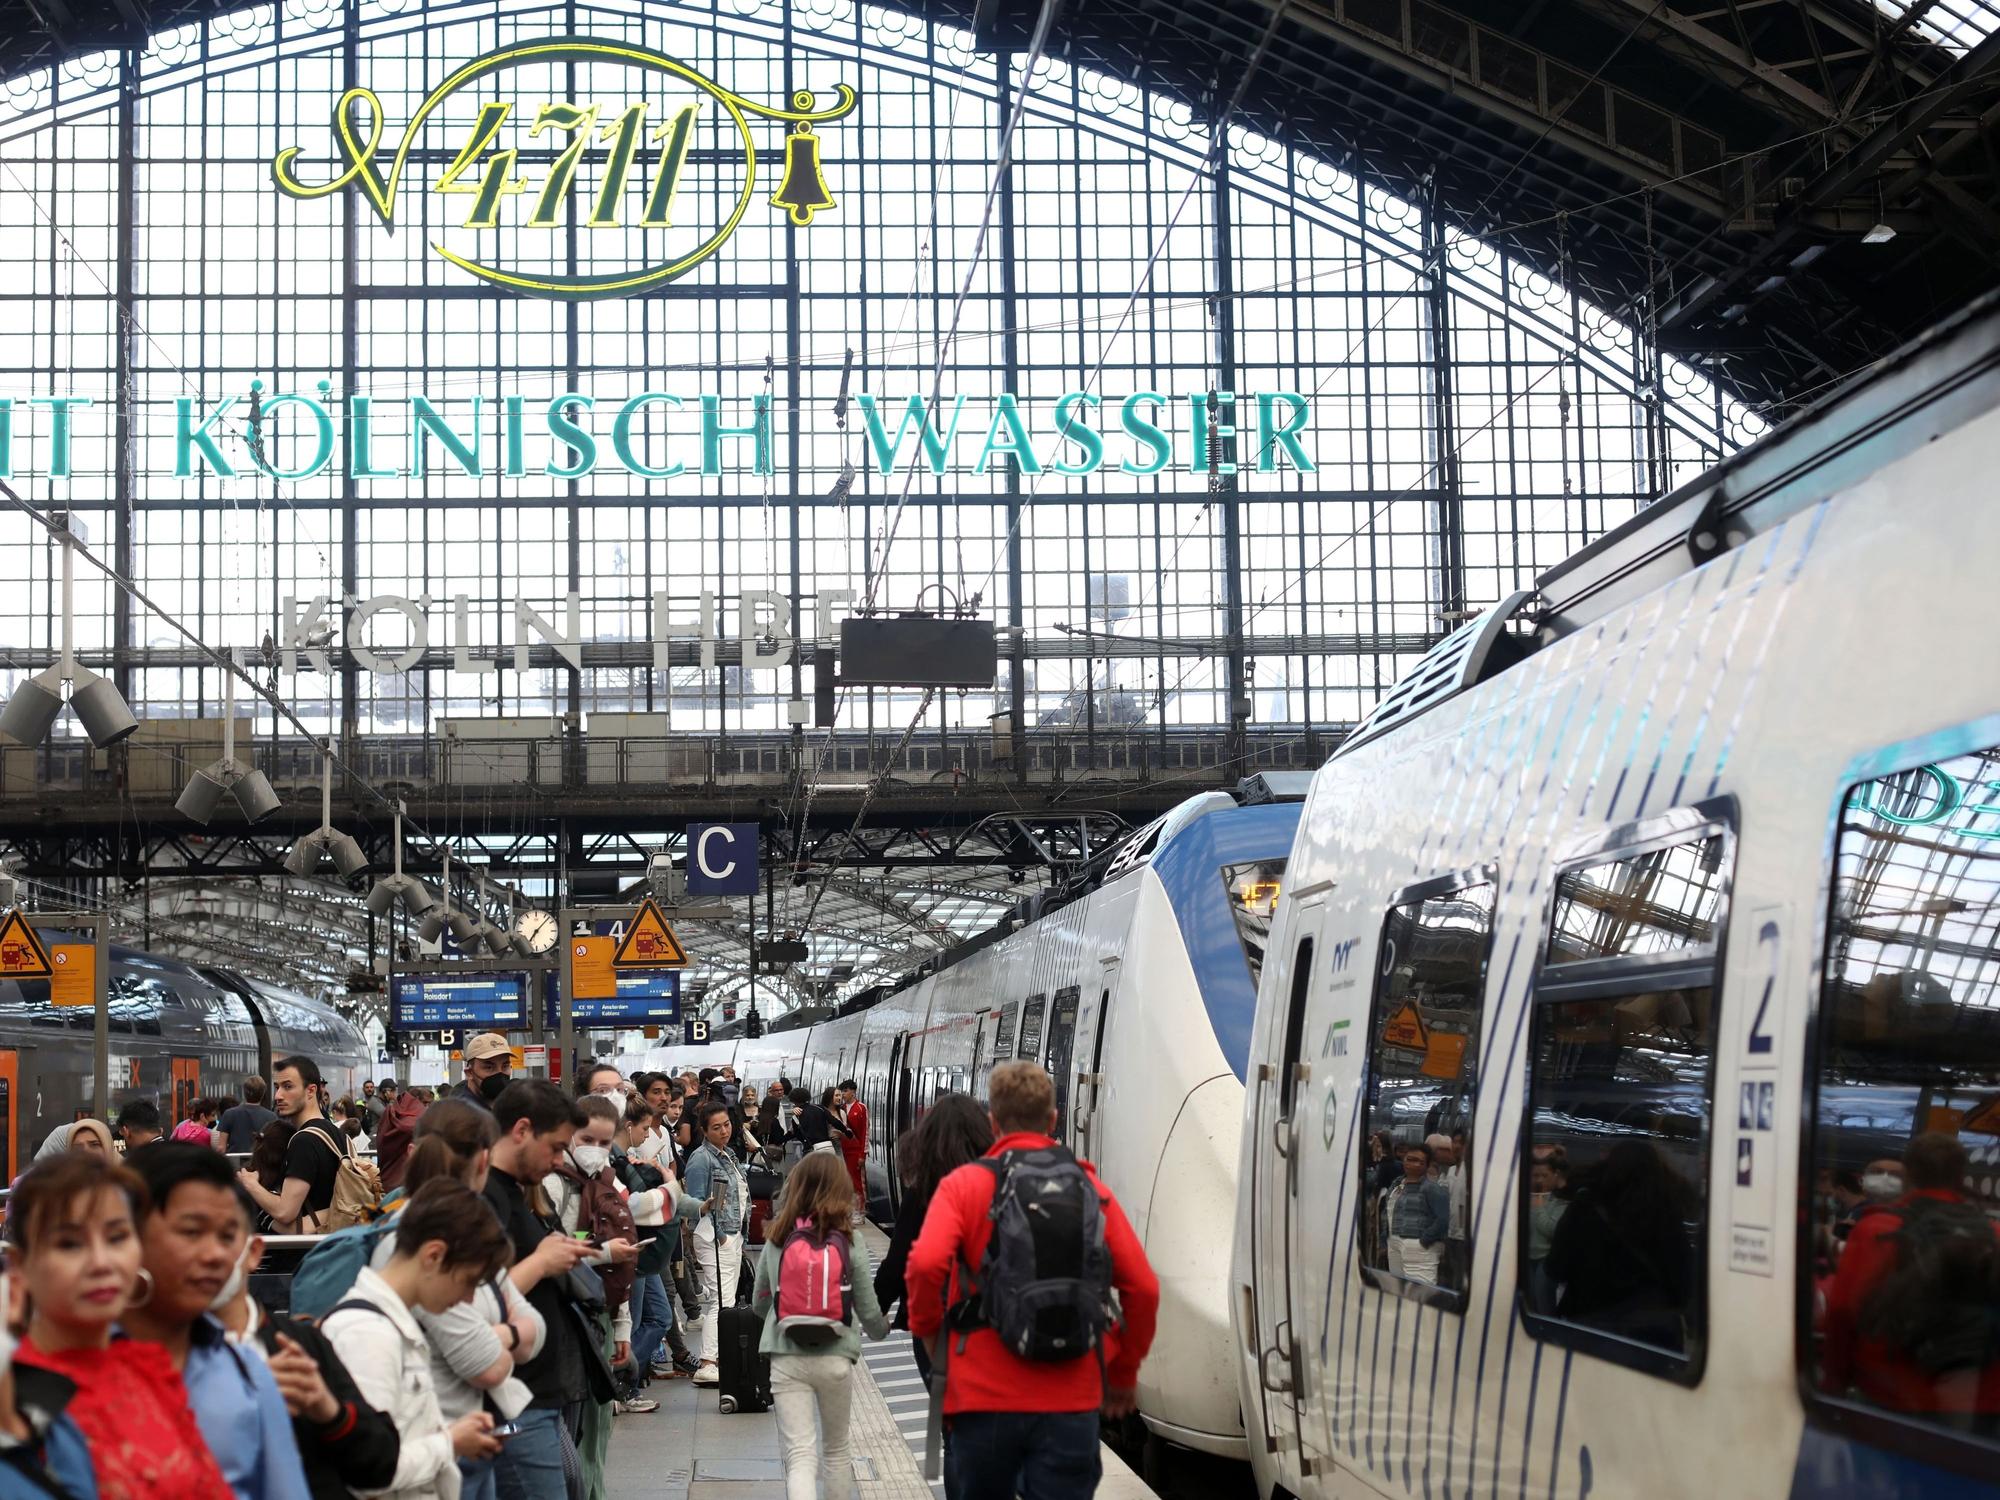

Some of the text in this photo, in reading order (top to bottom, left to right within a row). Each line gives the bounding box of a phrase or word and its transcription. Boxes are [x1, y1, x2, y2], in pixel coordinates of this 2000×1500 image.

[434, 101, 702, 229] 4711
[173, 377, 776, 481] KÖLNISCH
[855, 390, 1318, 476] WASSER
[282, 589, 857, 676] KÖLN HBF
[697, 826, 736, 879] C
[608, 919, 626, 944] 4
[1748, 920, 1781, 1054] 2
[441, 1028, 456, 1045] B
[693, 1022, 707, 1041] B
[380, 1049, 389, 1060] A
[36, 1092, 43, 1118] 2
